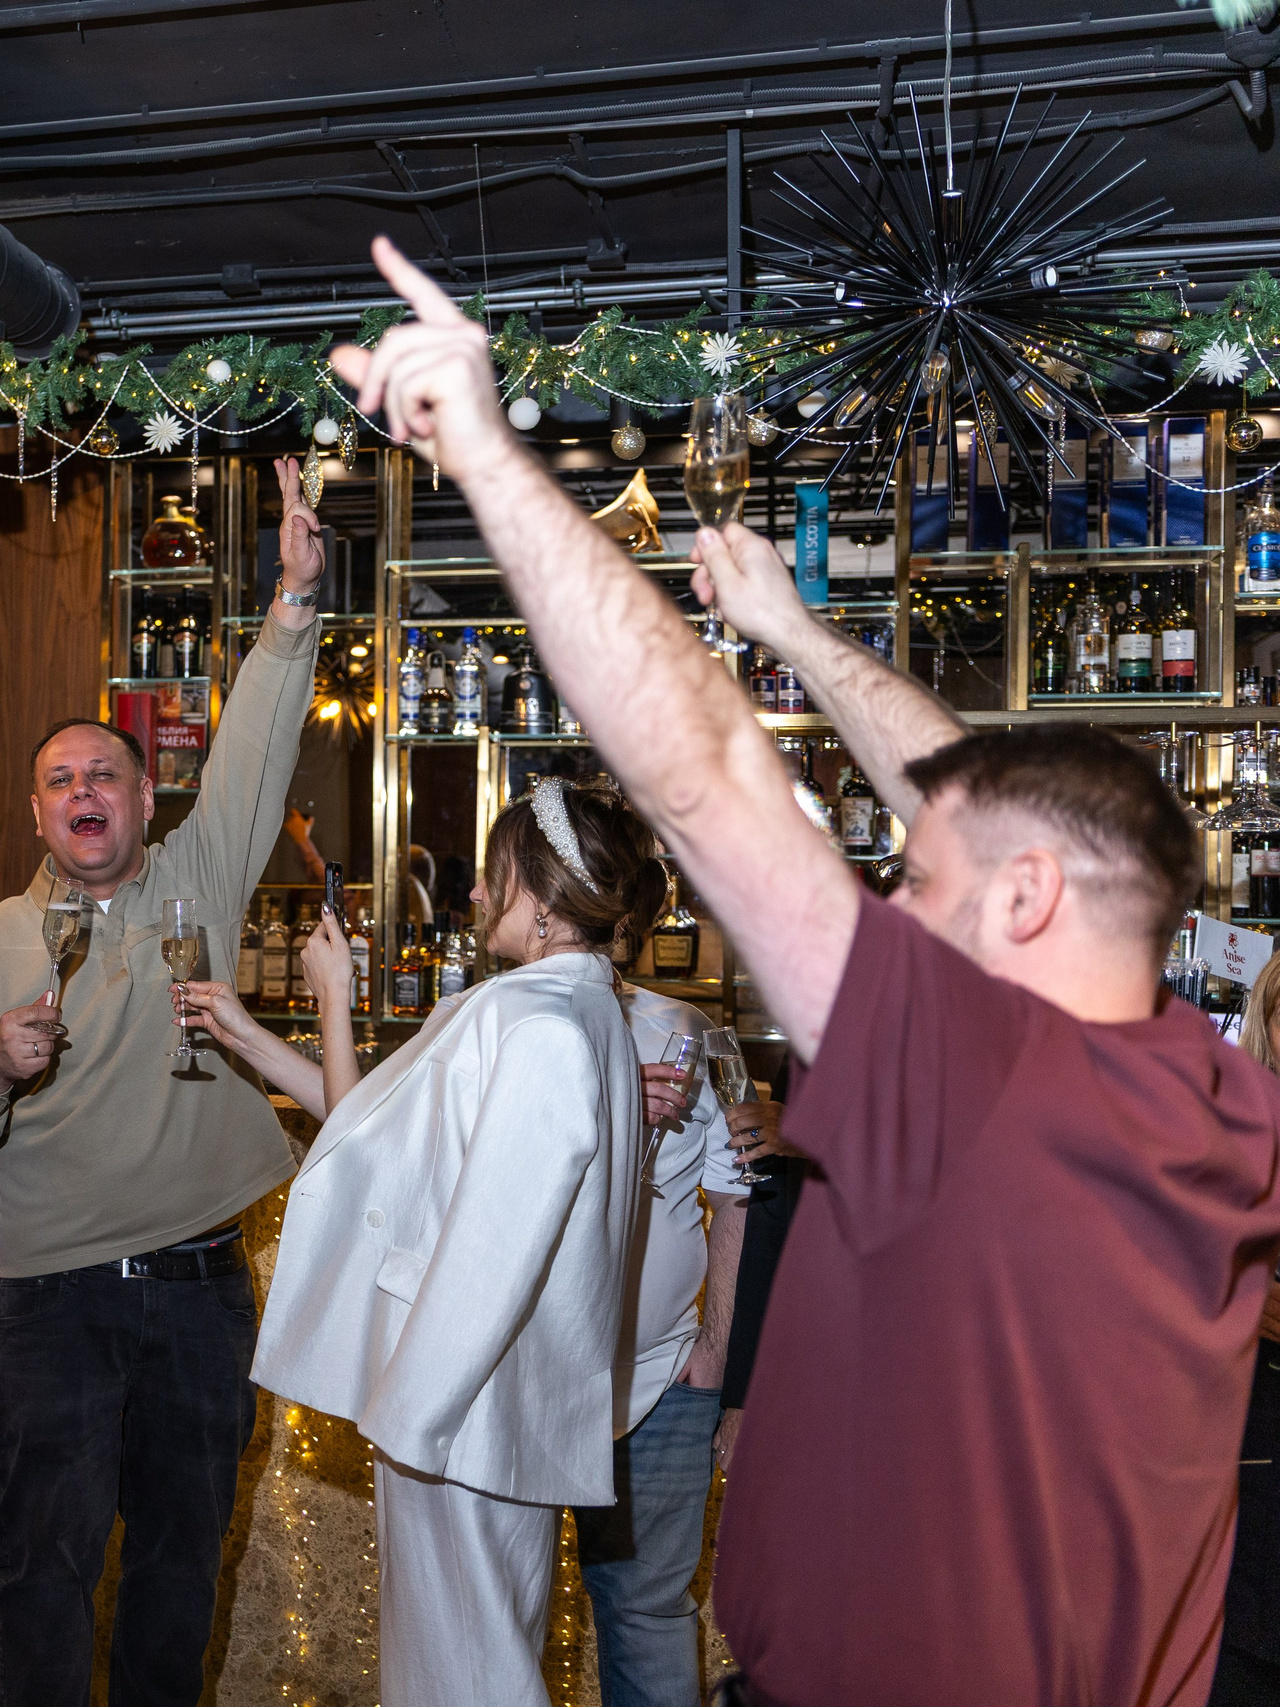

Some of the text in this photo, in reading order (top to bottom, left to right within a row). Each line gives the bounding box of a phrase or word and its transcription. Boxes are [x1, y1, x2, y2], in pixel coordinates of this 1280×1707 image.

[805, 505, 819, 583] GLEN SCOTIA
[1222, 948, 1246, 964] Anise
[1226, 962, 1242, 975] Sea
